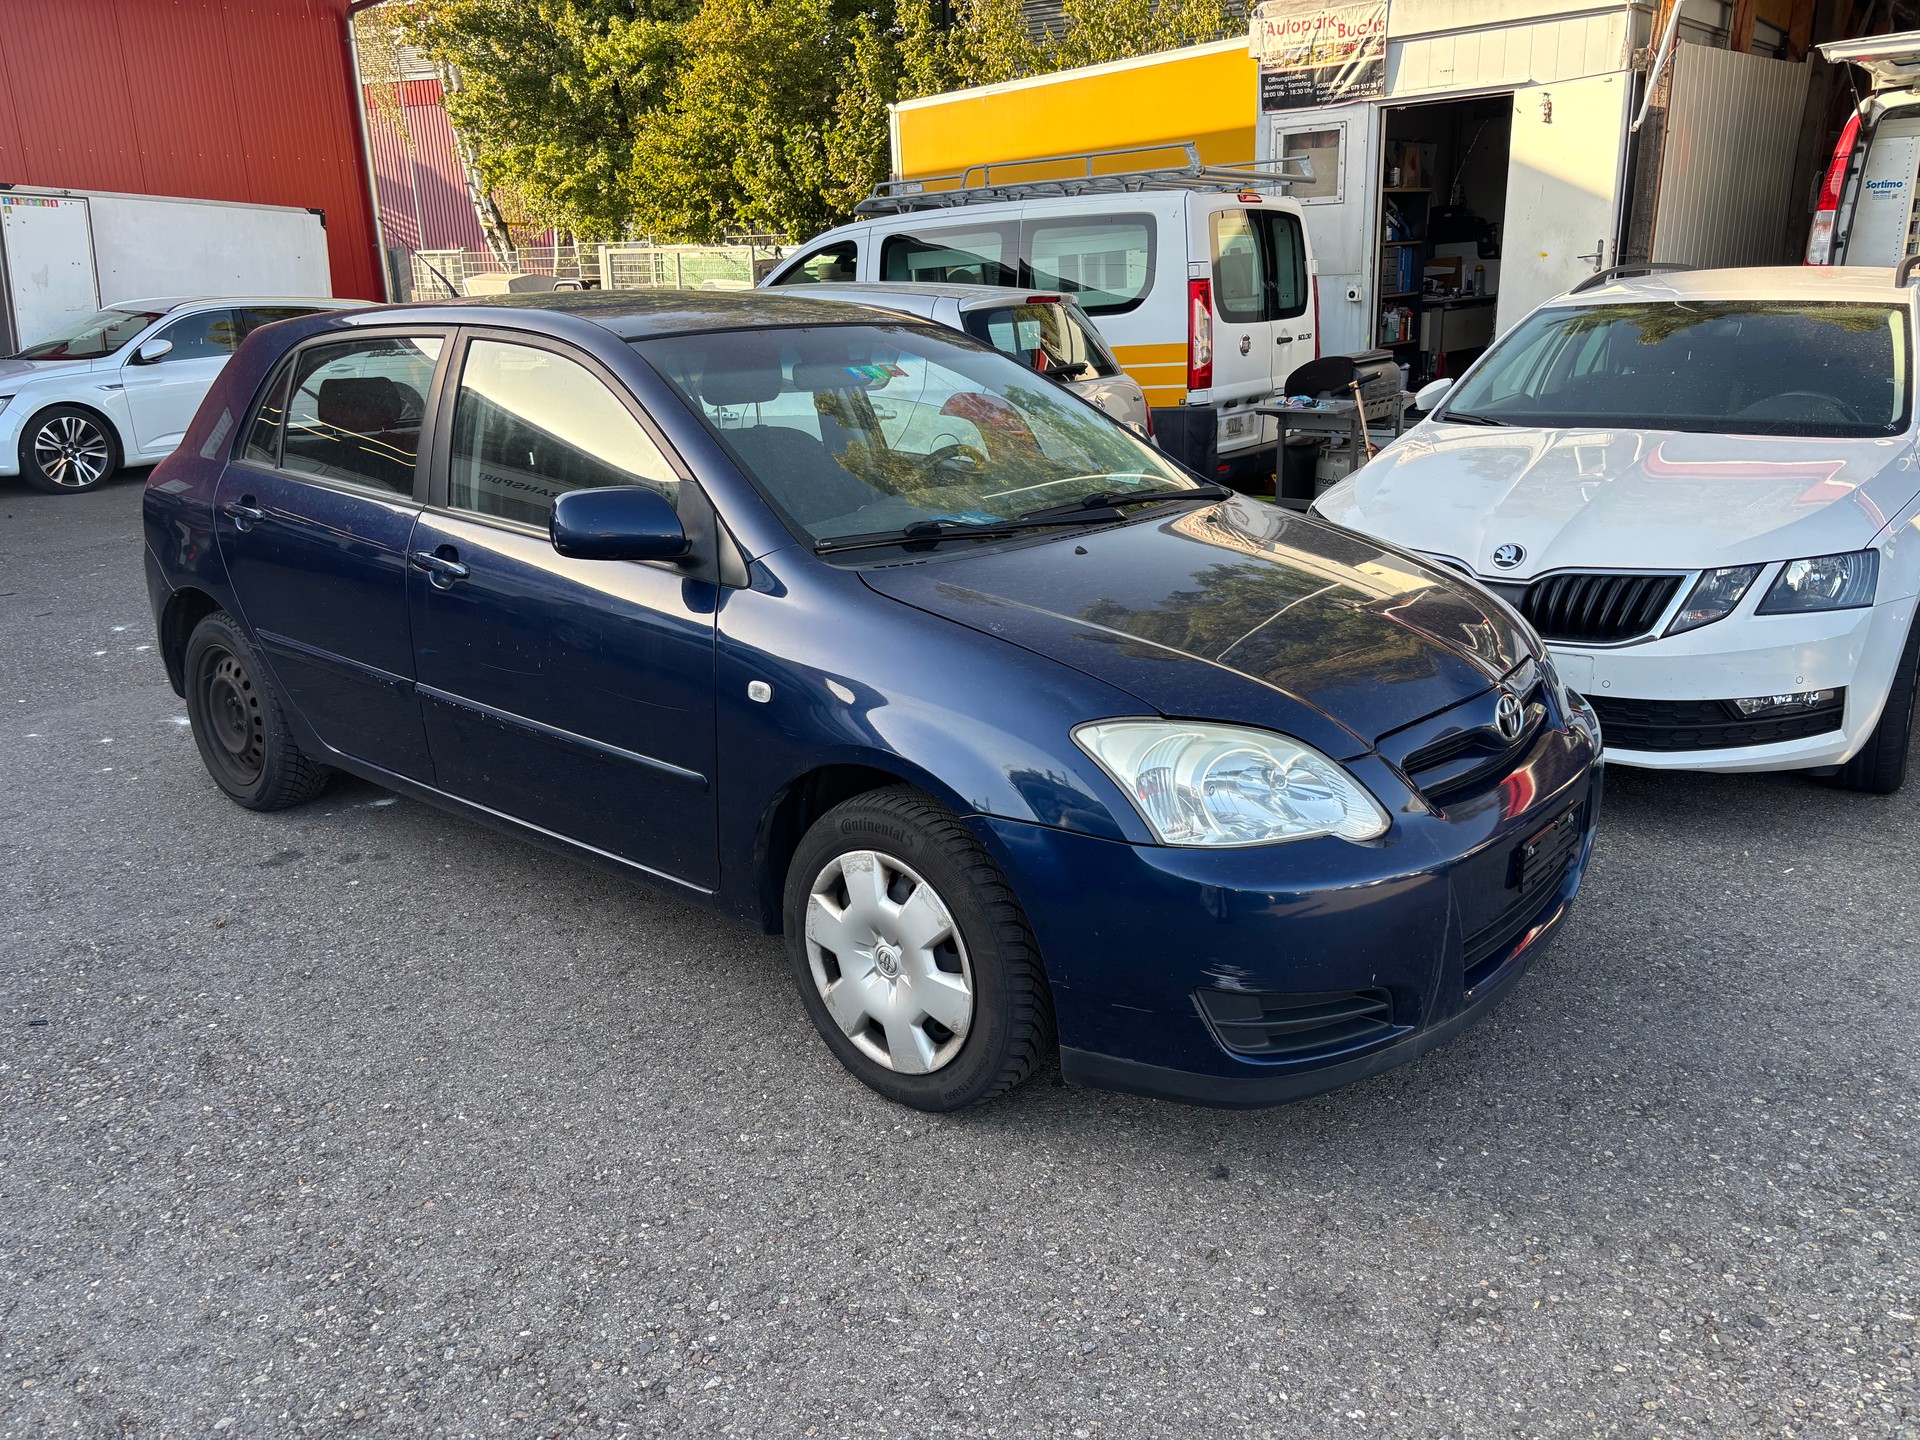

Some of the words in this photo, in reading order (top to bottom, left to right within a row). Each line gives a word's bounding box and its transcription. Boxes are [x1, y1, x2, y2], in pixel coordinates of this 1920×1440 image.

[1266, 16, 1337, 35] Autopark
[1866, 180, 1903, 189] Sortimo
[841, 817, 904, 842] Continental
